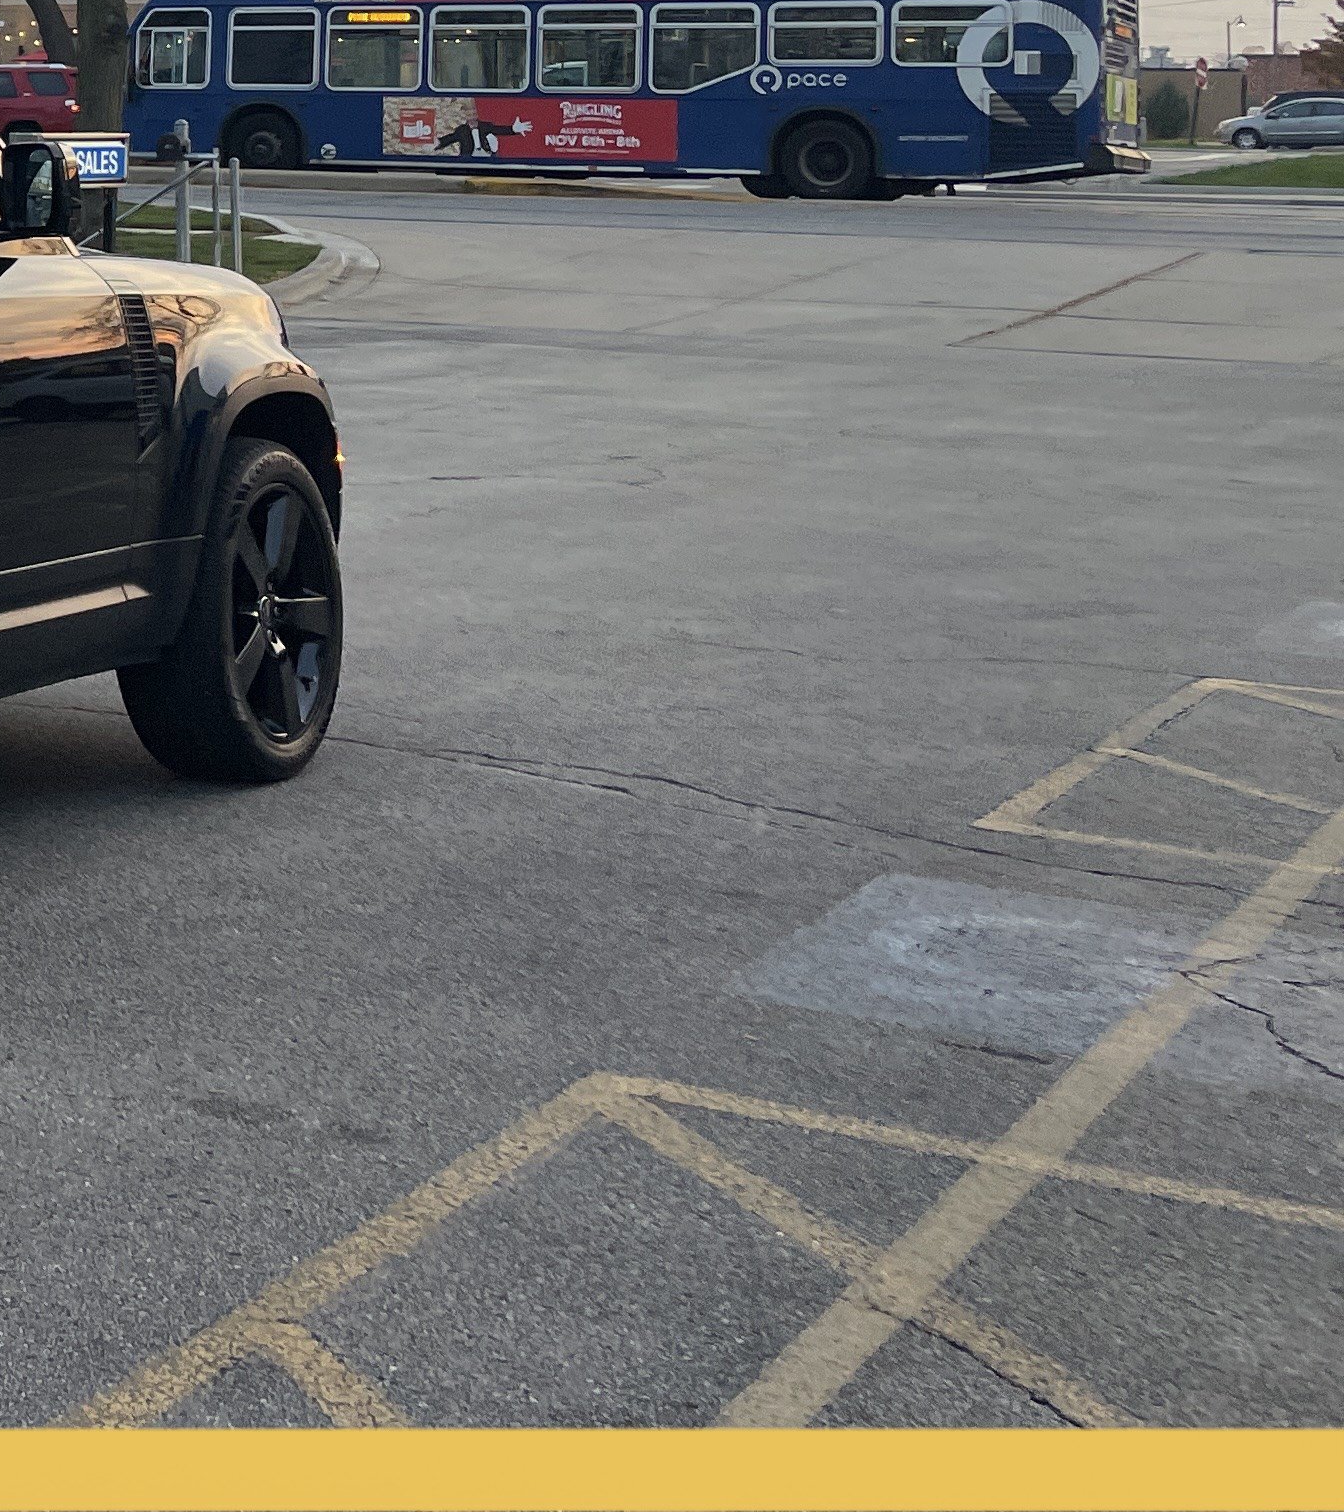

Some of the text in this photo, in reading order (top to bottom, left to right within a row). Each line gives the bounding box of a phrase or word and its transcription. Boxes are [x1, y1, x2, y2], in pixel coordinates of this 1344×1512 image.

[786, 73, 848, 89] pace
[545, 135, 578, 146] NOV
[76, 150, 119, 176] SALES
